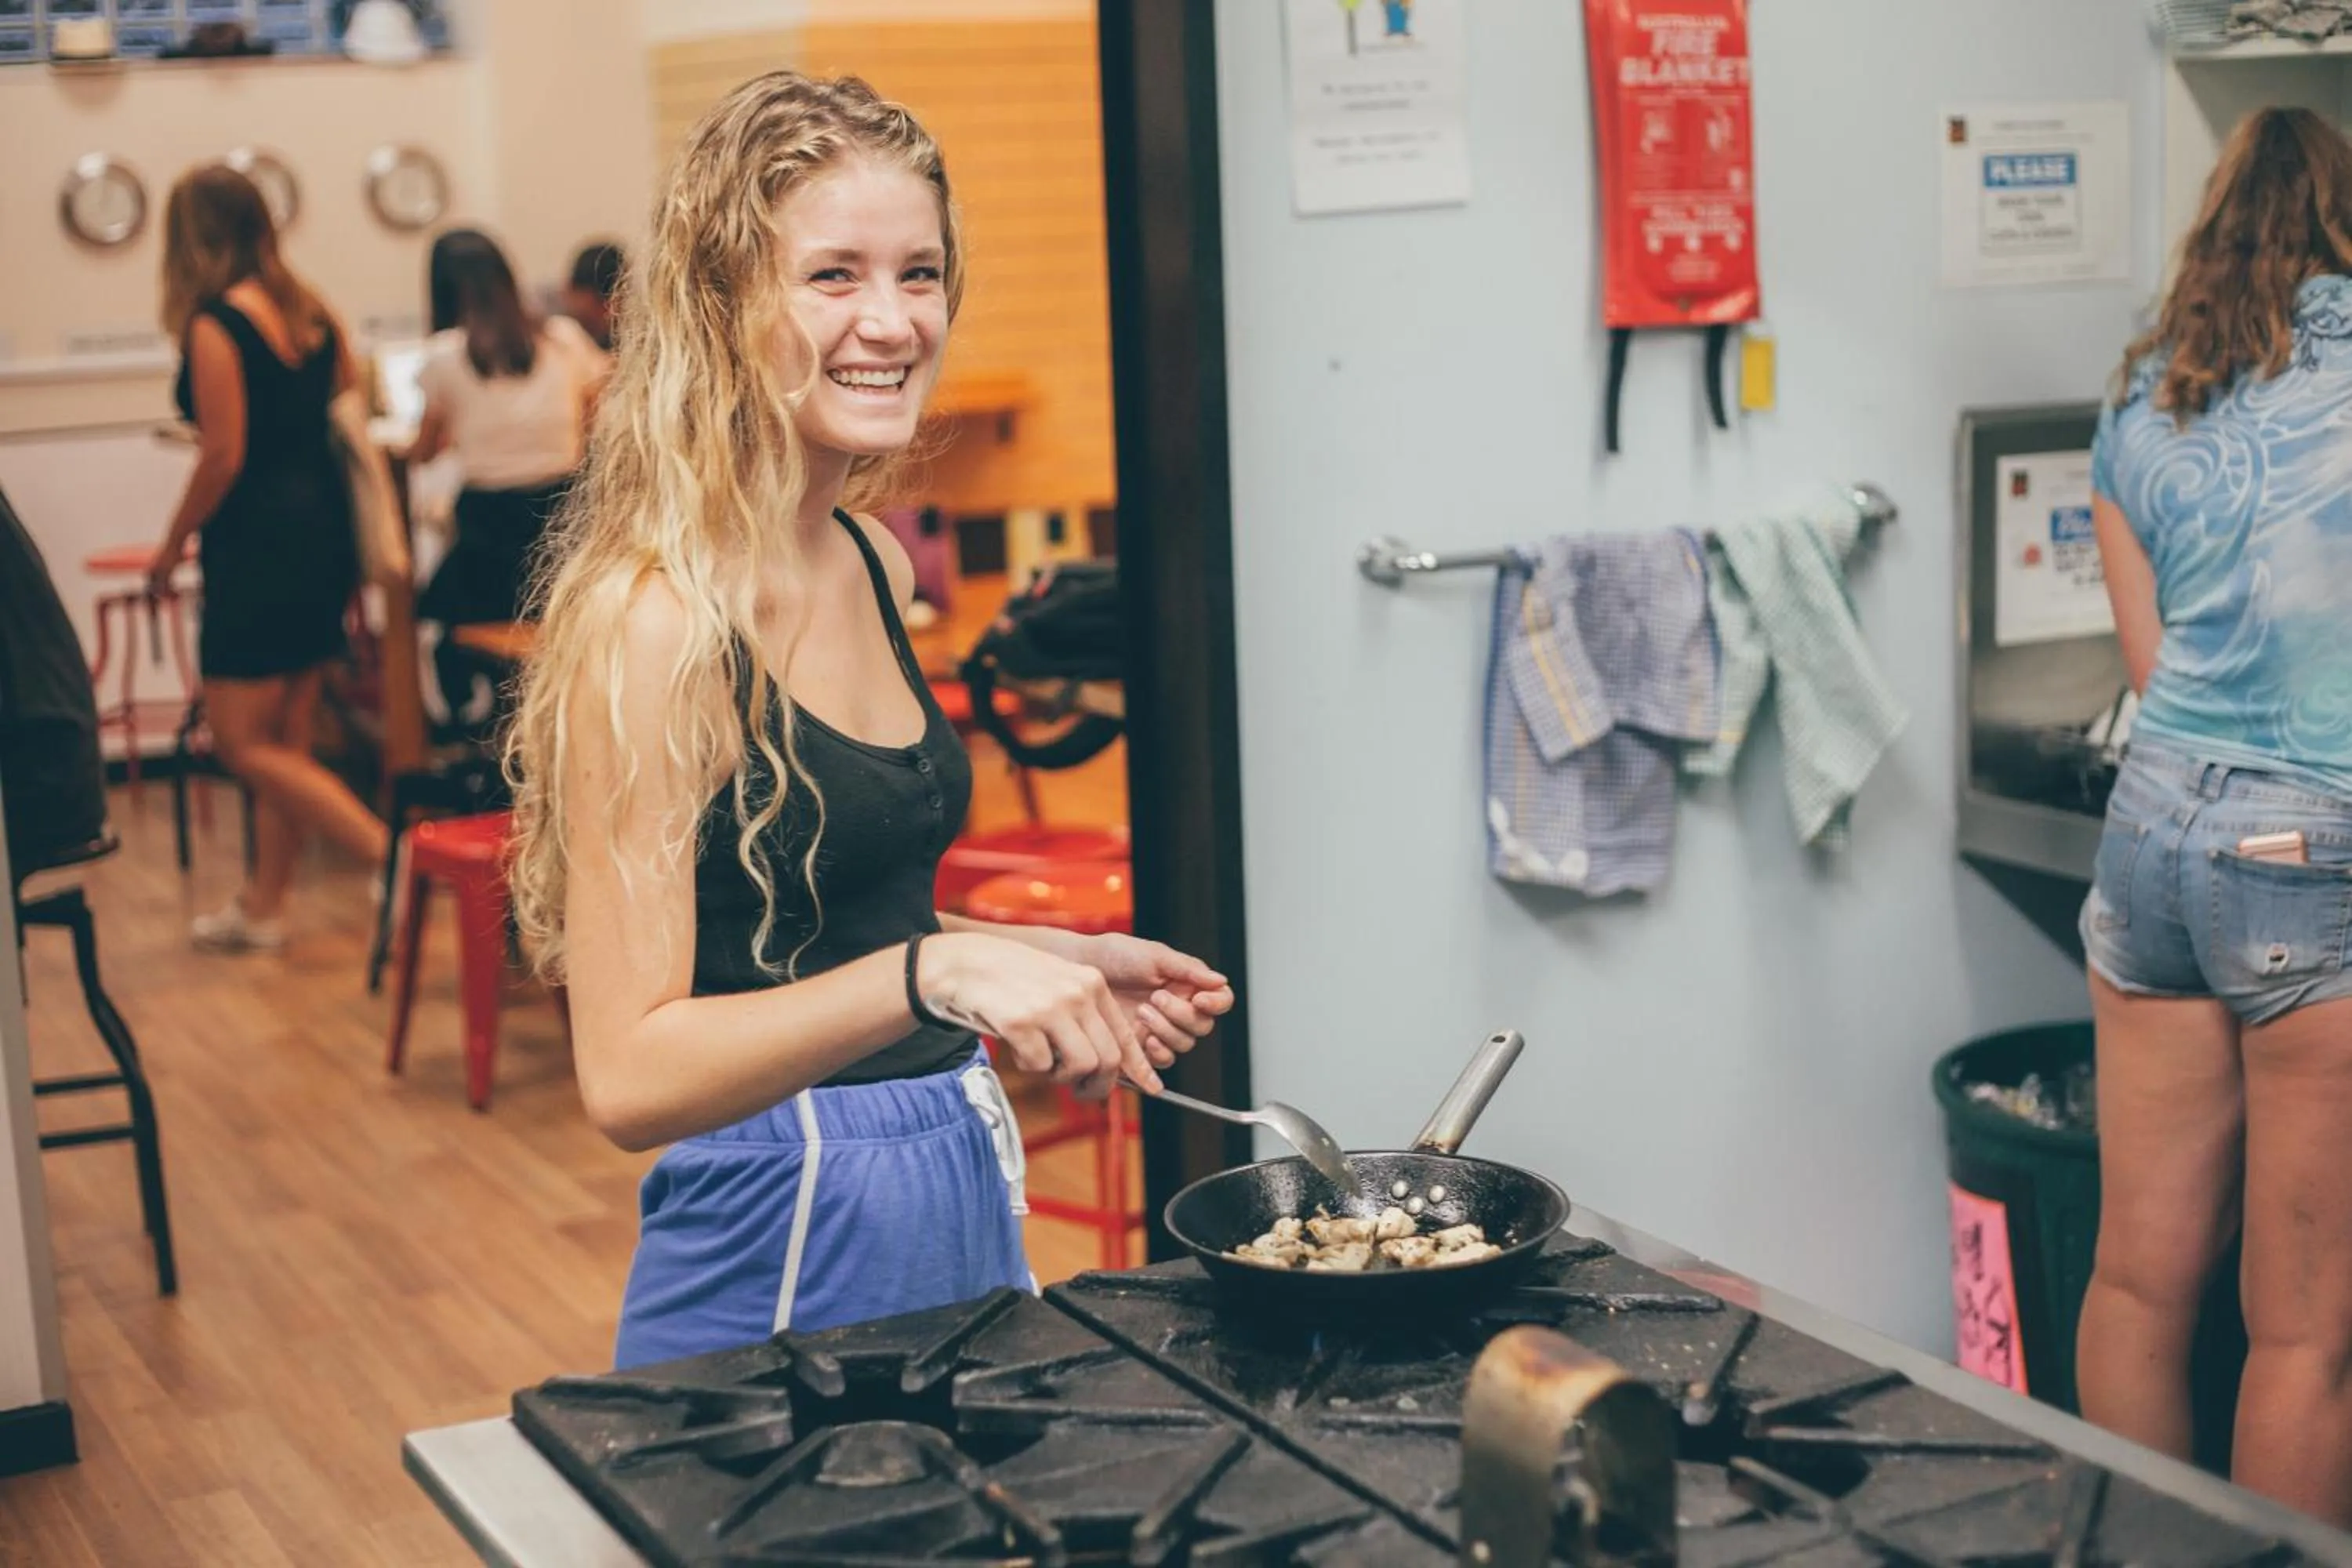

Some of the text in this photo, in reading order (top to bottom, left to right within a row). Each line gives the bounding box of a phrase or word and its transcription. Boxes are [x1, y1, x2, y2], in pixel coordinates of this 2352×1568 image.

[1650, 30, 1718, 55] FIRE
[1620, 56, 1750, 86] BLANKET
[1990, 157, 2069, 181] PLEASE
